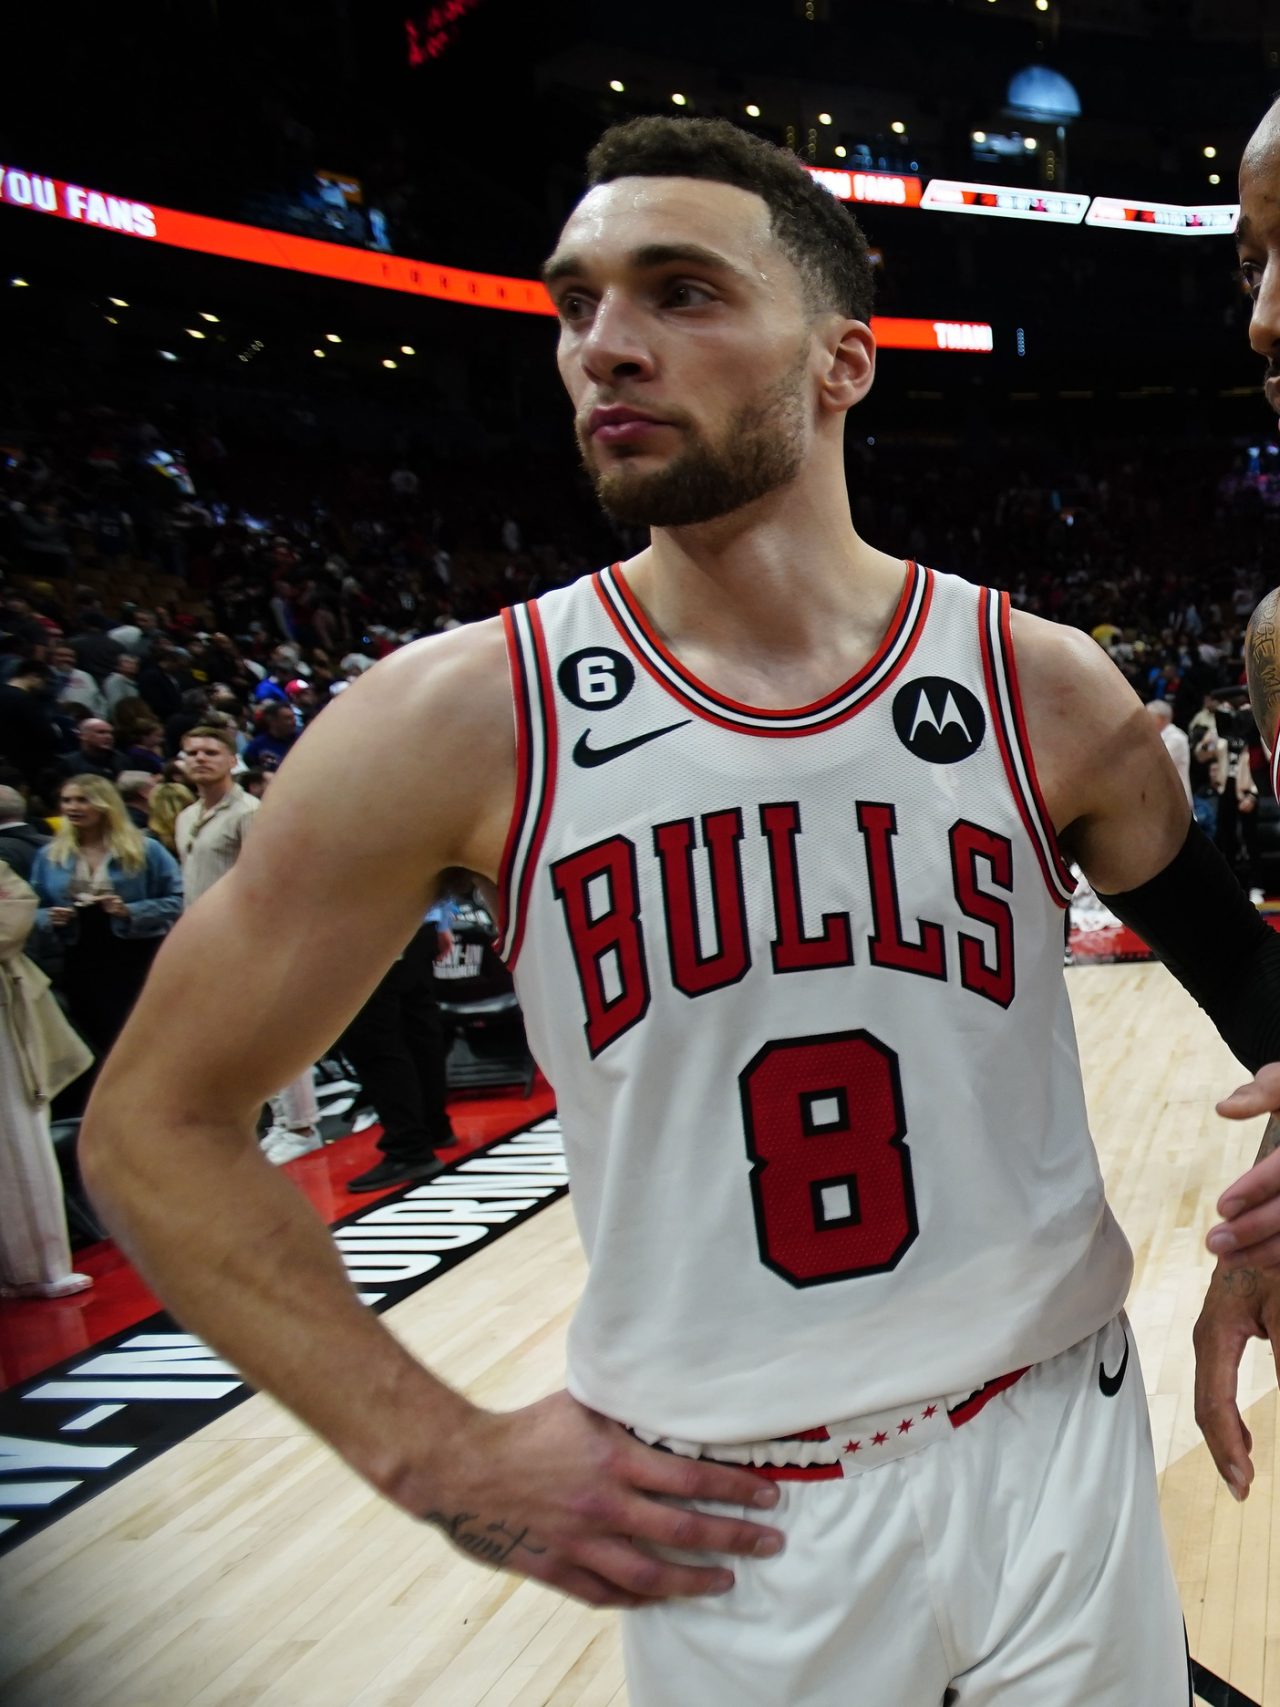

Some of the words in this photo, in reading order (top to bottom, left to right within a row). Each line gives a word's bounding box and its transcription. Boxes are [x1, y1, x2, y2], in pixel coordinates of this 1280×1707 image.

[67, 186, 157, 237] FANS
[576, 655, 618, 702] 6
[549, 800, 1016, 1060] BULLS
[738, 1028, 920, 1289] 8
